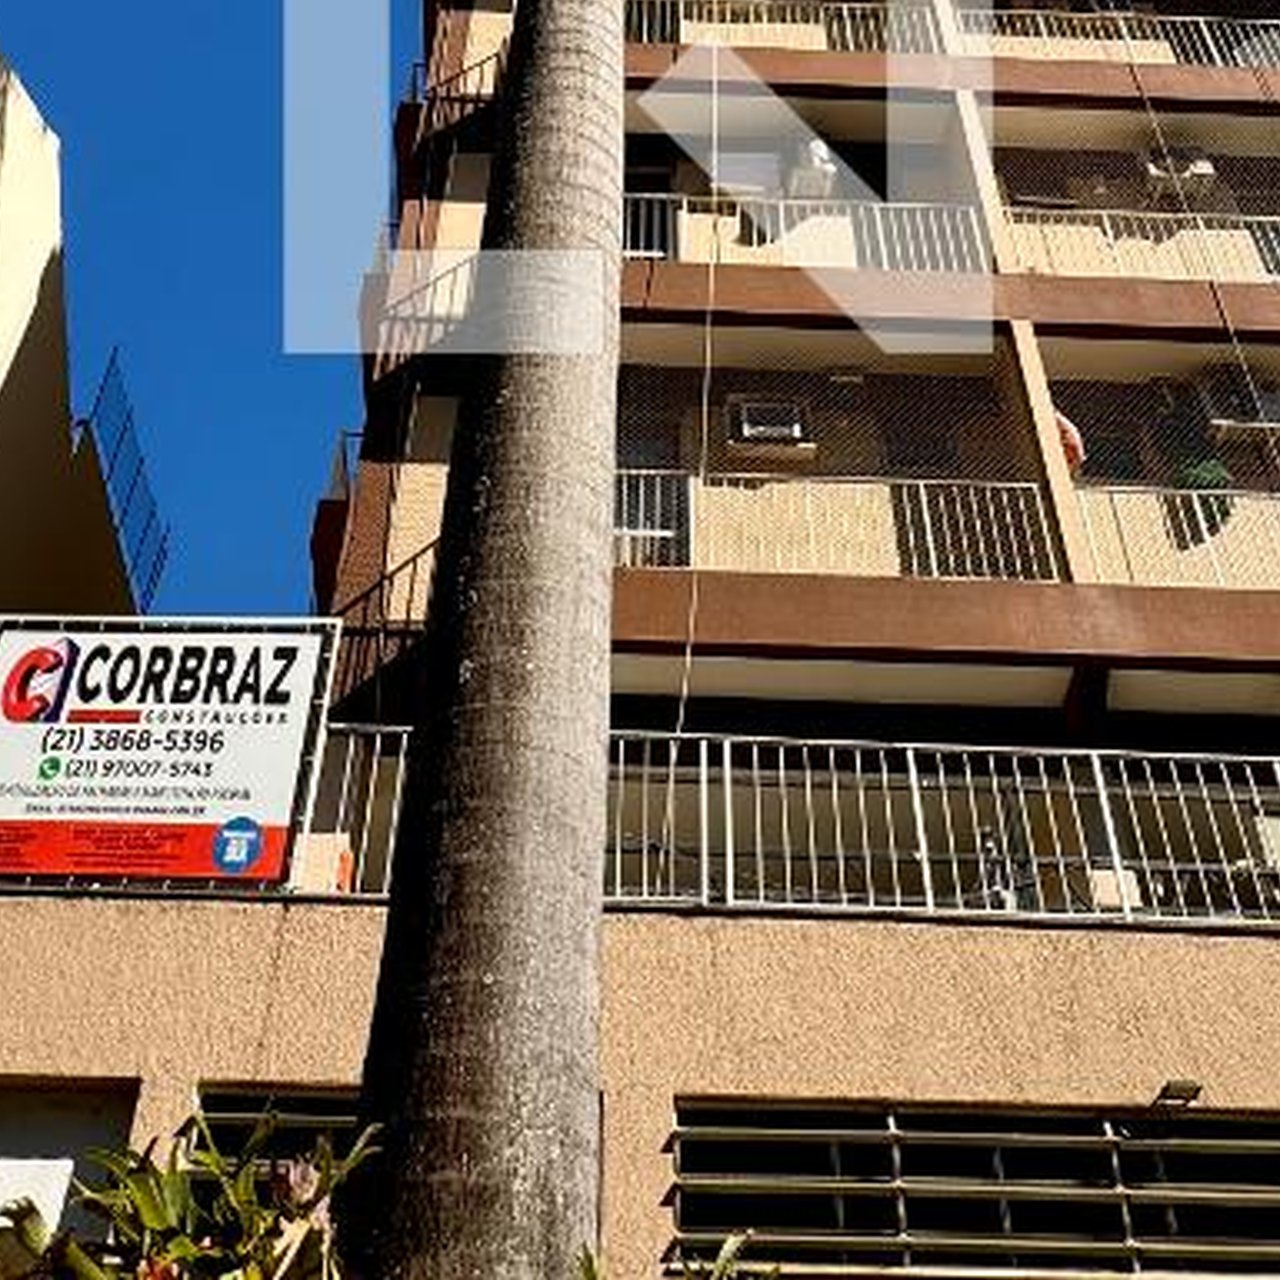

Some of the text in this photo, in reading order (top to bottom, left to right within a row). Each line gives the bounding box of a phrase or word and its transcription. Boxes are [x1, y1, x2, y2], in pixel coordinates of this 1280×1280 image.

[77, 644, 299, 705] CORBRAZ
[42, 726, 224, 754] (21) 3868-5396
[65, 759, 97, 778] (21)
